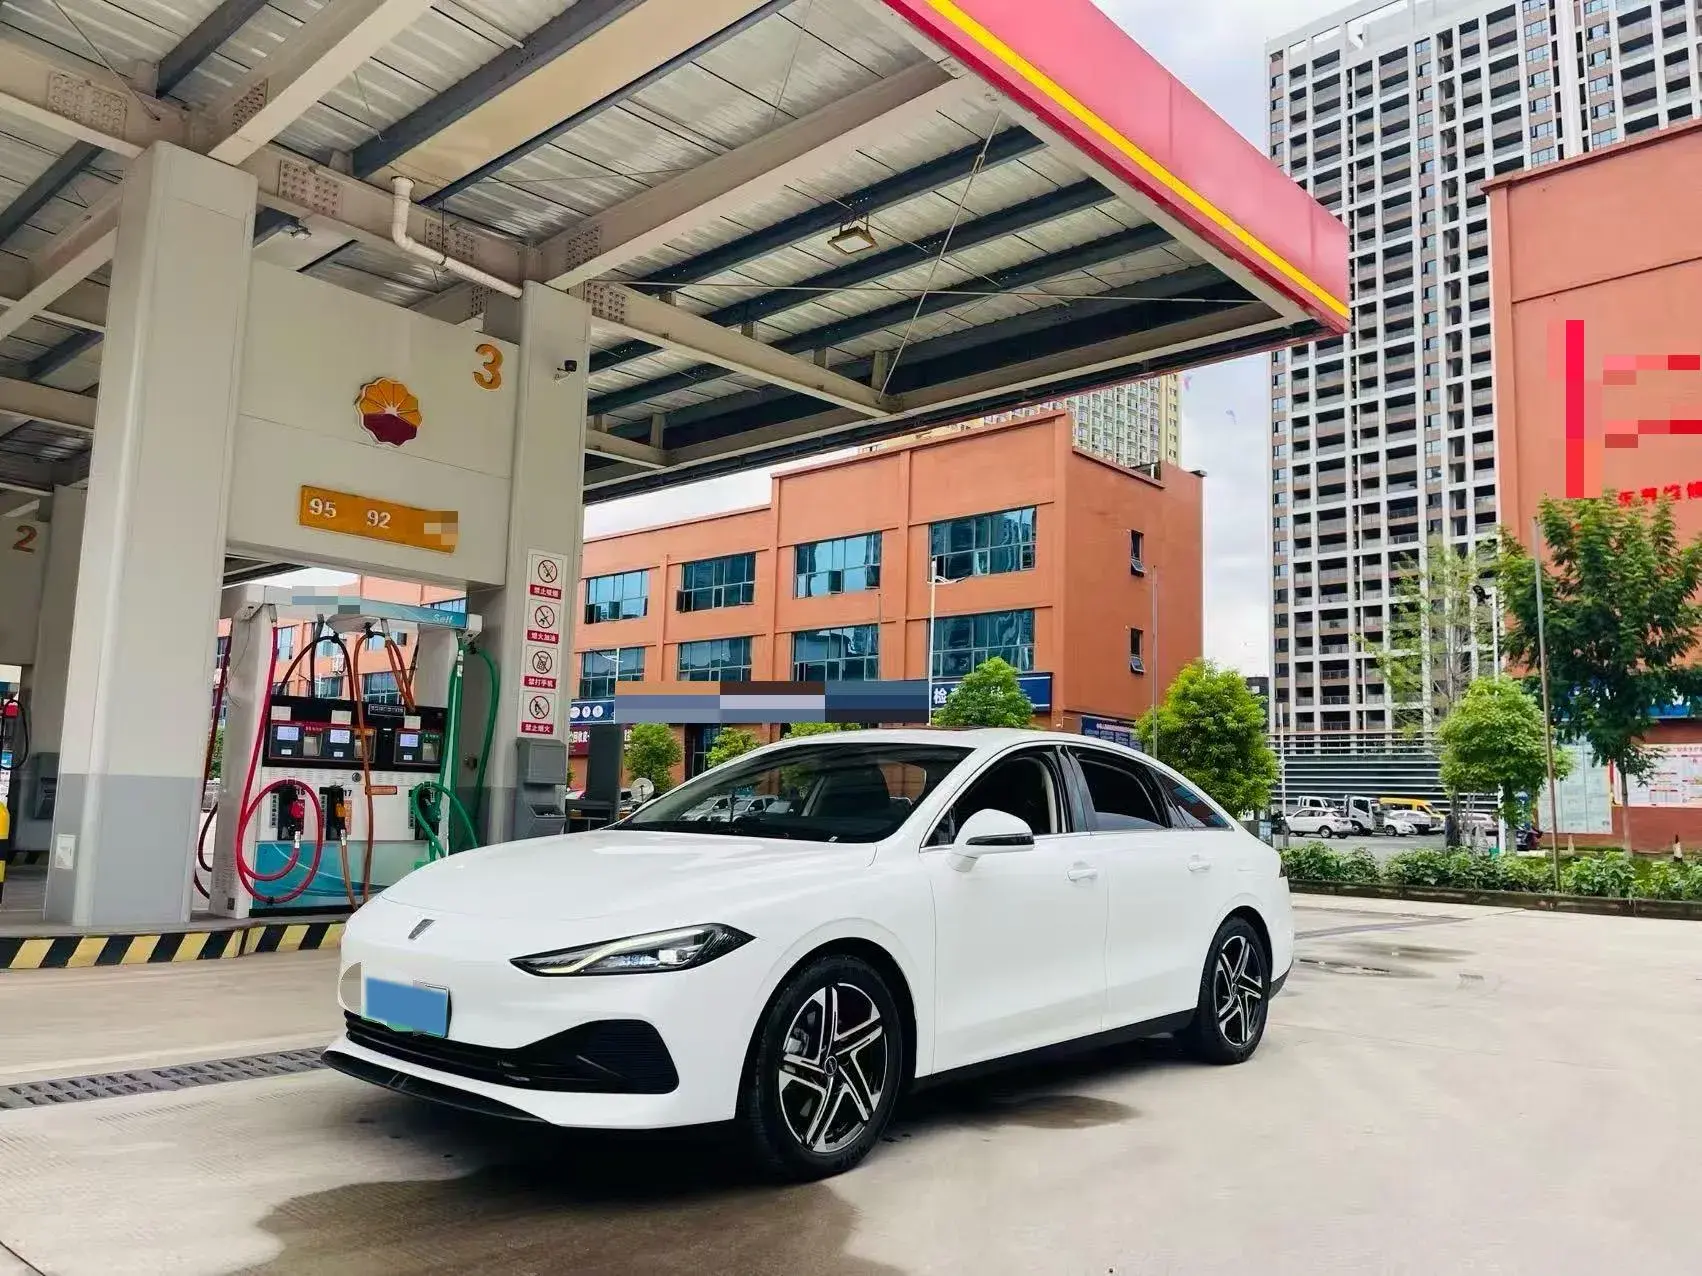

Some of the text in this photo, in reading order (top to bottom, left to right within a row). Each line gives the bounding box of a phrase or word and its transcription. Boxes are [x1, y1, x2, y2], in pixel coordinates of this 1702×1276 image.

[473, 344, 503, 390] 3
[309, 498, 391, 529] 95 92
[12, 525, 38, 552] 2
[433, 613, 454, 624] Self
